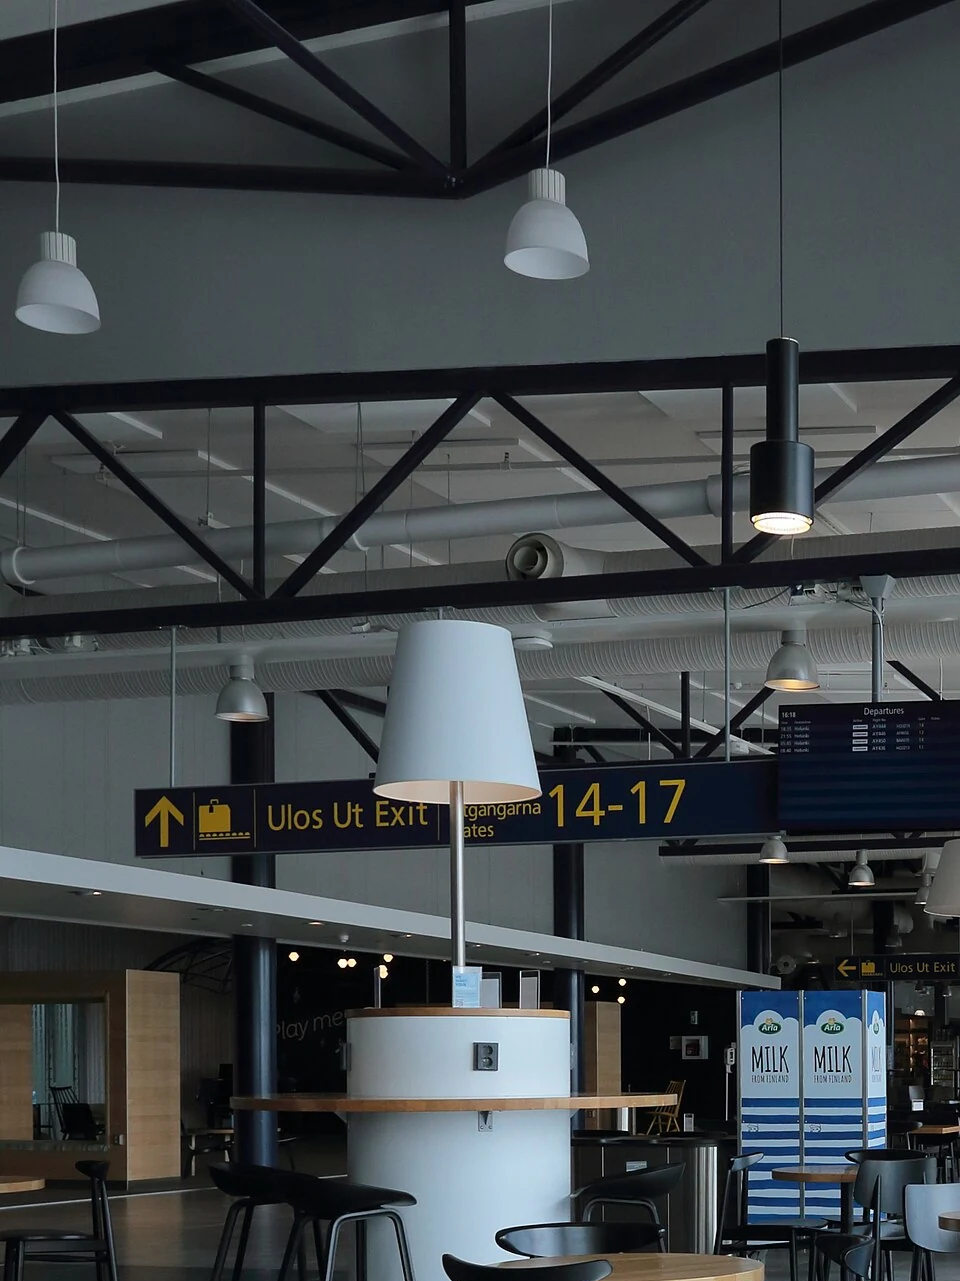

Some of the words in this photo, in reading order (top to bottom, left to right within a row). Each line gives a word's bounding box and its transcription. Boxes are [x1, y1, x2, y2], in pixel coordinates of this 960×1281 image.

[863, 707, 905, 717] Departures
[548, 779, 686, 827] 14-17
[267, 803, 324, 831] Ulos
[333, 801, 364, 829] Ut
[375, 800, 428, 827] Exit
[464, 823, 495, 838] ates
[889, 961, 913, 973] Ulos
[916, 961, 930, 973] Ut
[933, 960, 956, 973] Exit
[761, 1023, 778, 1032] Arla
[823, 1023, 841, 1032] Arla
[752, 1045, 789, 1073] MILK
[814, 1045, 852, 1073] MILK
[752, 1074, 765, 1083] FROM
[766, 1074, 789, 1083] FINLAND
[814, 1074, 828, 1083] FROM
[828, 1074, 852, 1083] FINLAND
